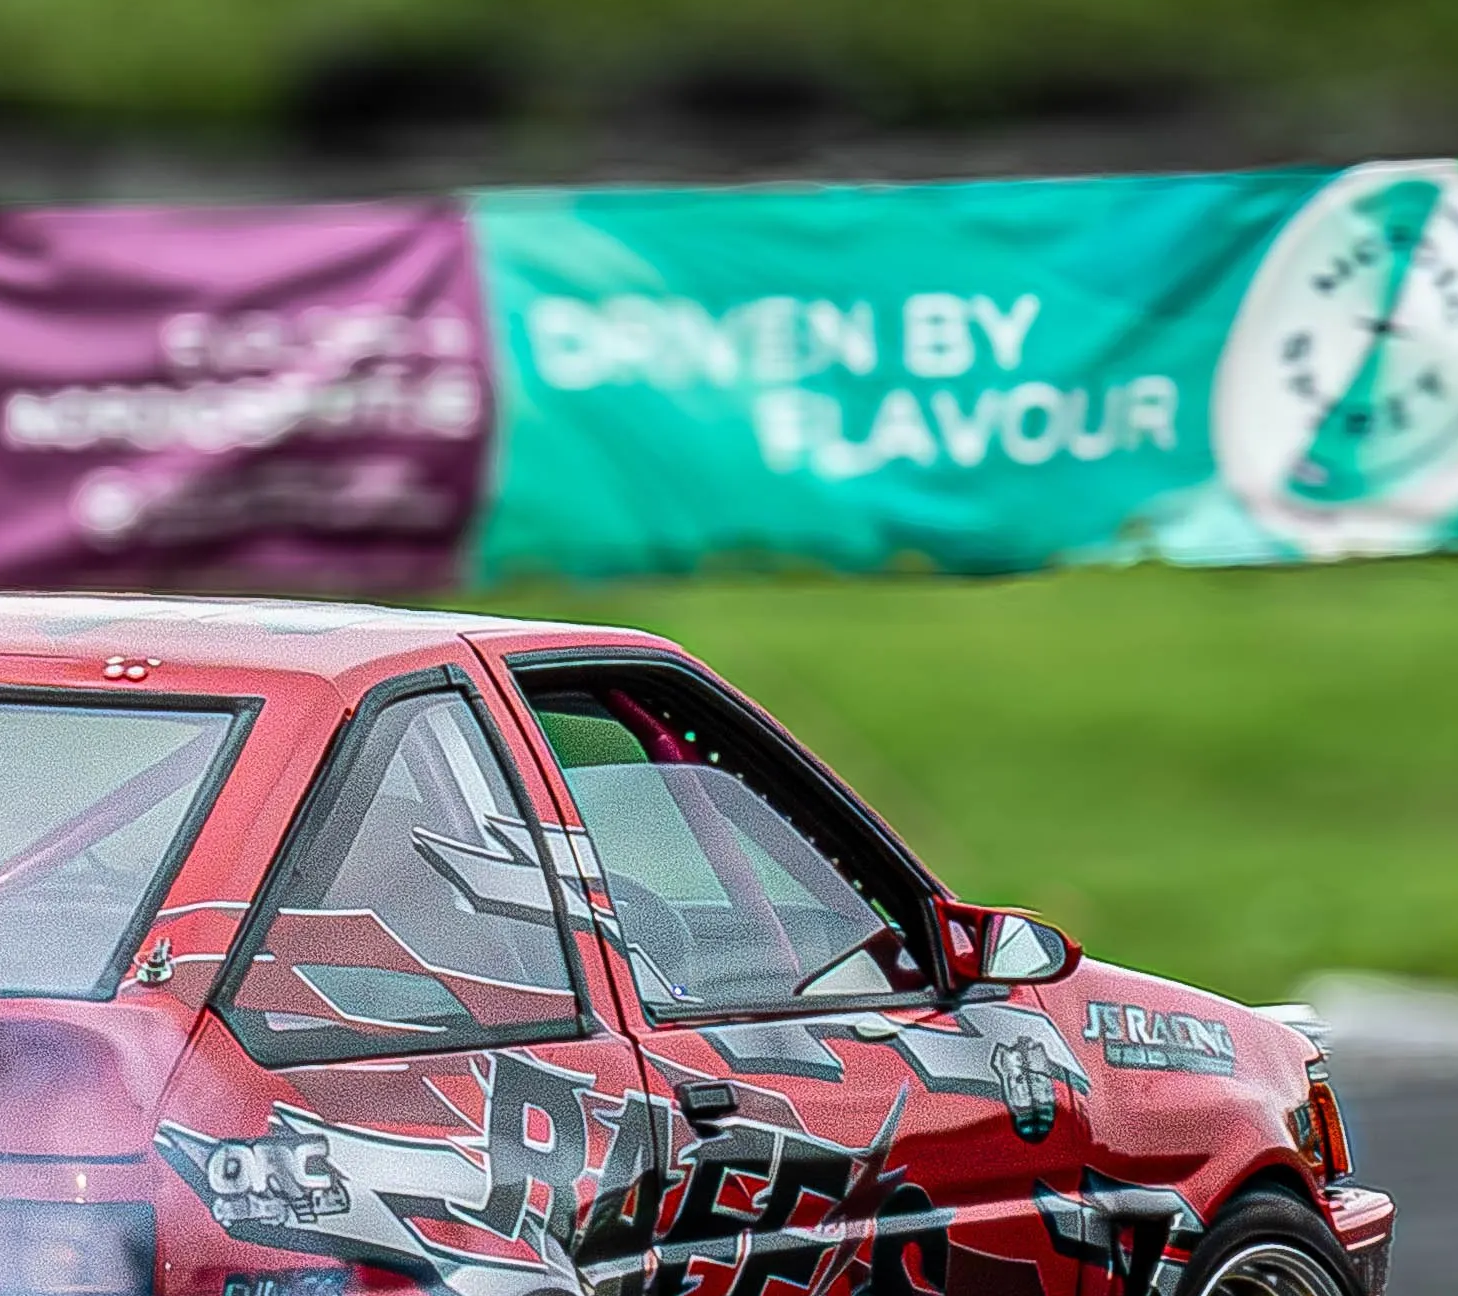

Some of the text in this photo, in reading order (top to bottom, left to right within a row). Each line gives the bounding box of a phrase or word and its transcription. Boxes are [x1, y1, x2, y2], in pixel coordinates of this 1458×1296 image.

[527, 295, 877, 392] DRIVEN
[902, 291, 1042, 377] BY
[752, 375, 1178, 478] FLAVOUR
